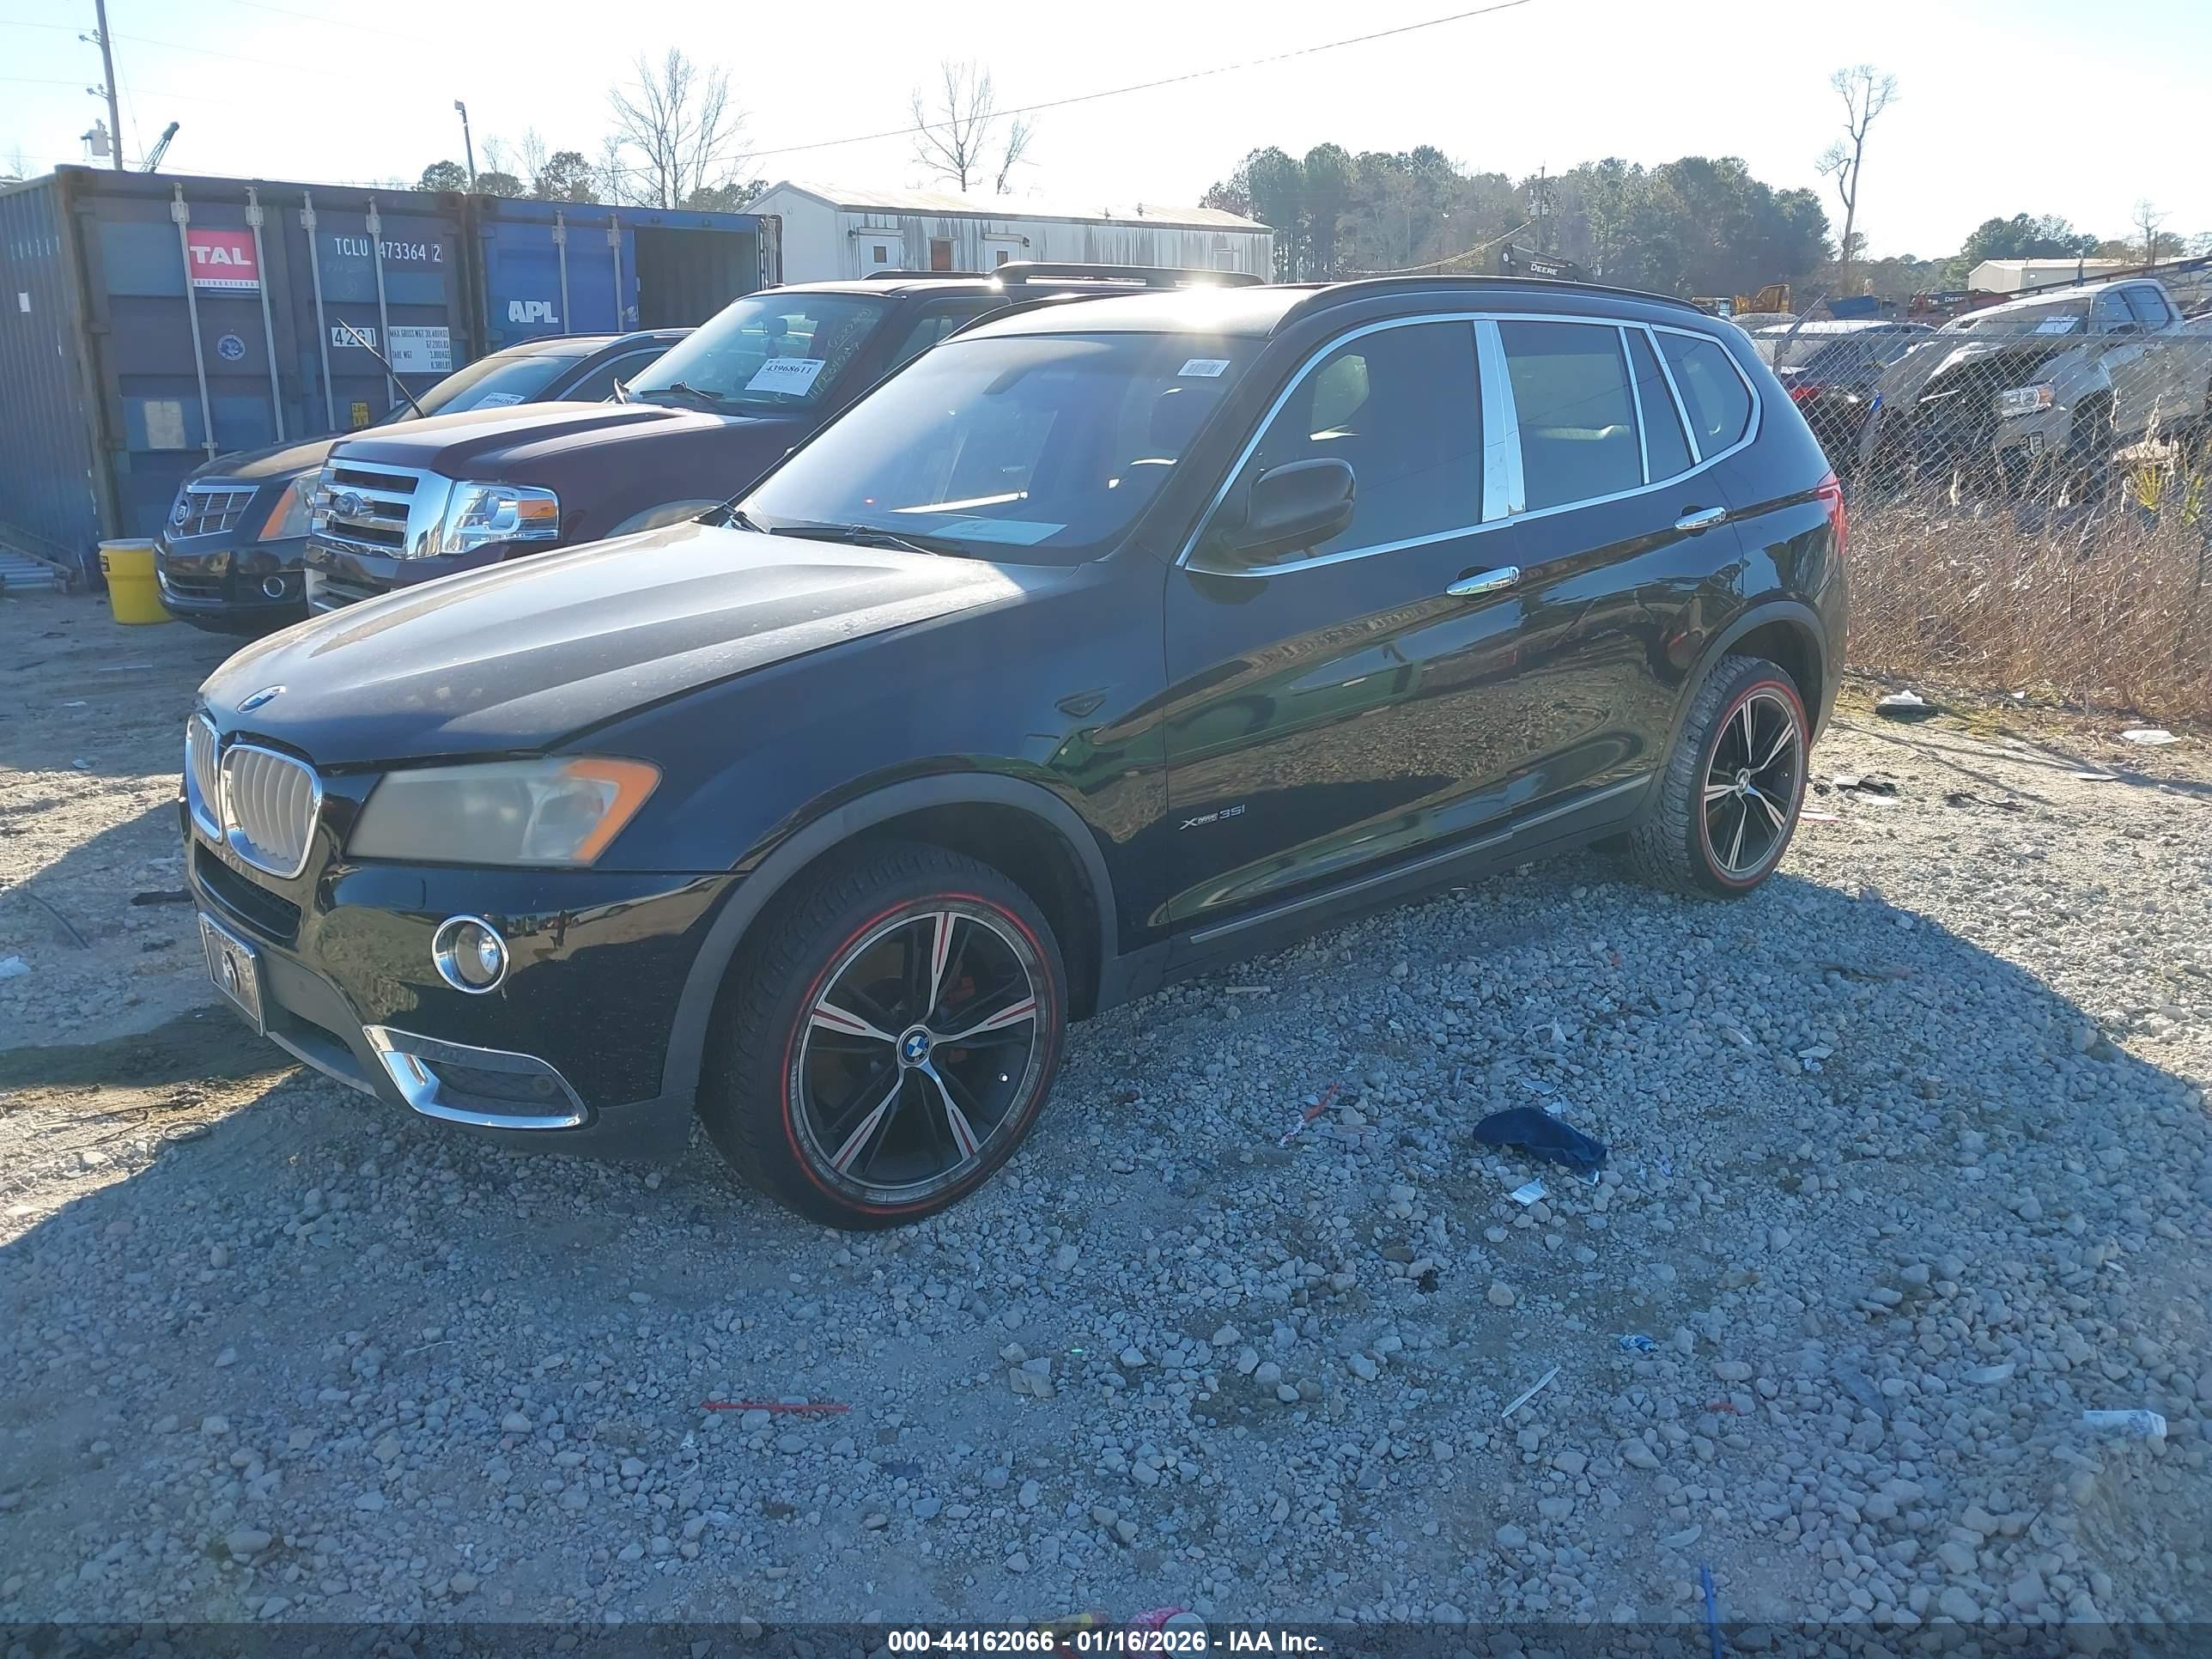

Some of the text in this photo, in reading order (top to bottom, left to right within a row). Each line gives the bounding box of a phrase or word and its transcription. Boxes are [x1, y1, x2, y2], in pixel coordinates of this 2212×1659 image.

[189, 246, 252, 265] TAL
[334, 238, 442, 262] TCLU 473364 2
[1530, 263, 1559, 275] DEERE
[508, 301, 558, 324] APL
